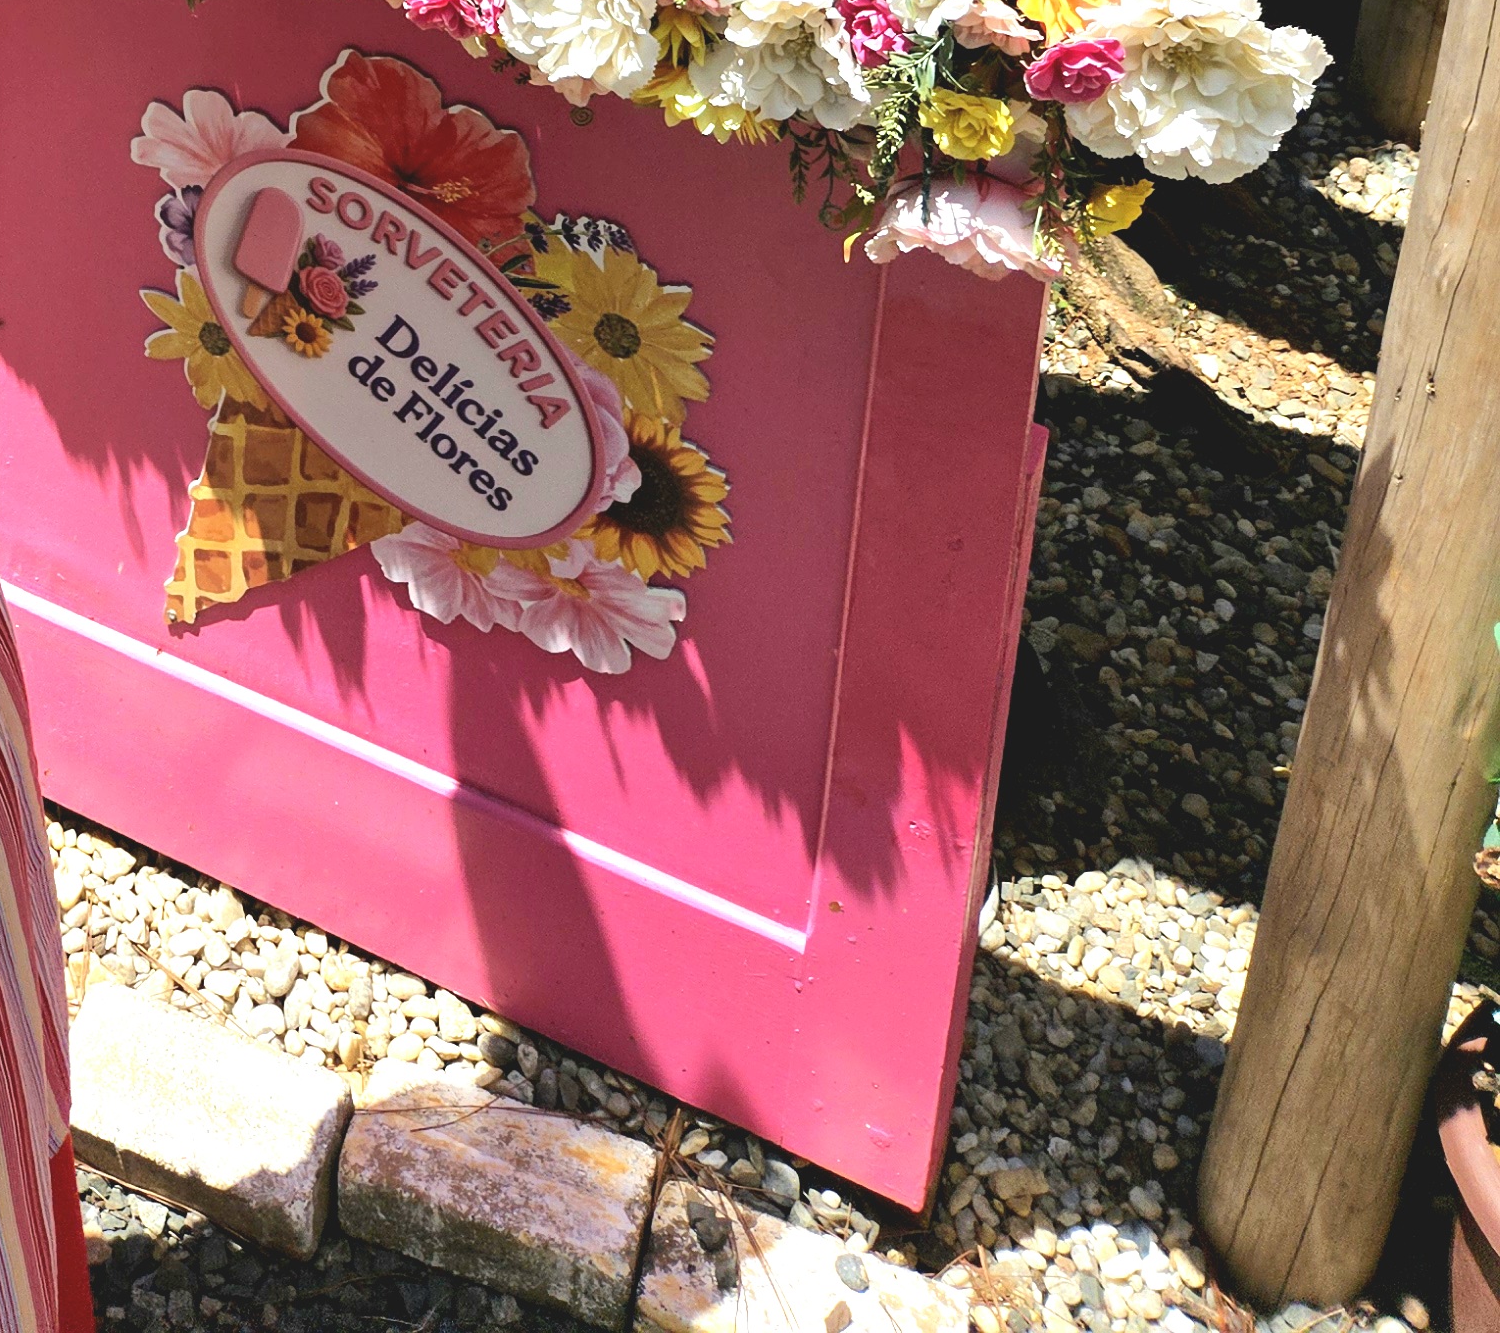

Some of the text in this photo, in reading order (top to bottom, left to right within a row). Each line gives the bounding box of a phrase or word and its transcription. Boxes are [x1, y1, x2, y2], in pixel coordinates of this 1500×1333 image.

[305, 175, 571, 429] SORVETERIA
[347, 353, 513, 512] de Flores
[374, 314, 540, 477] Delícias
